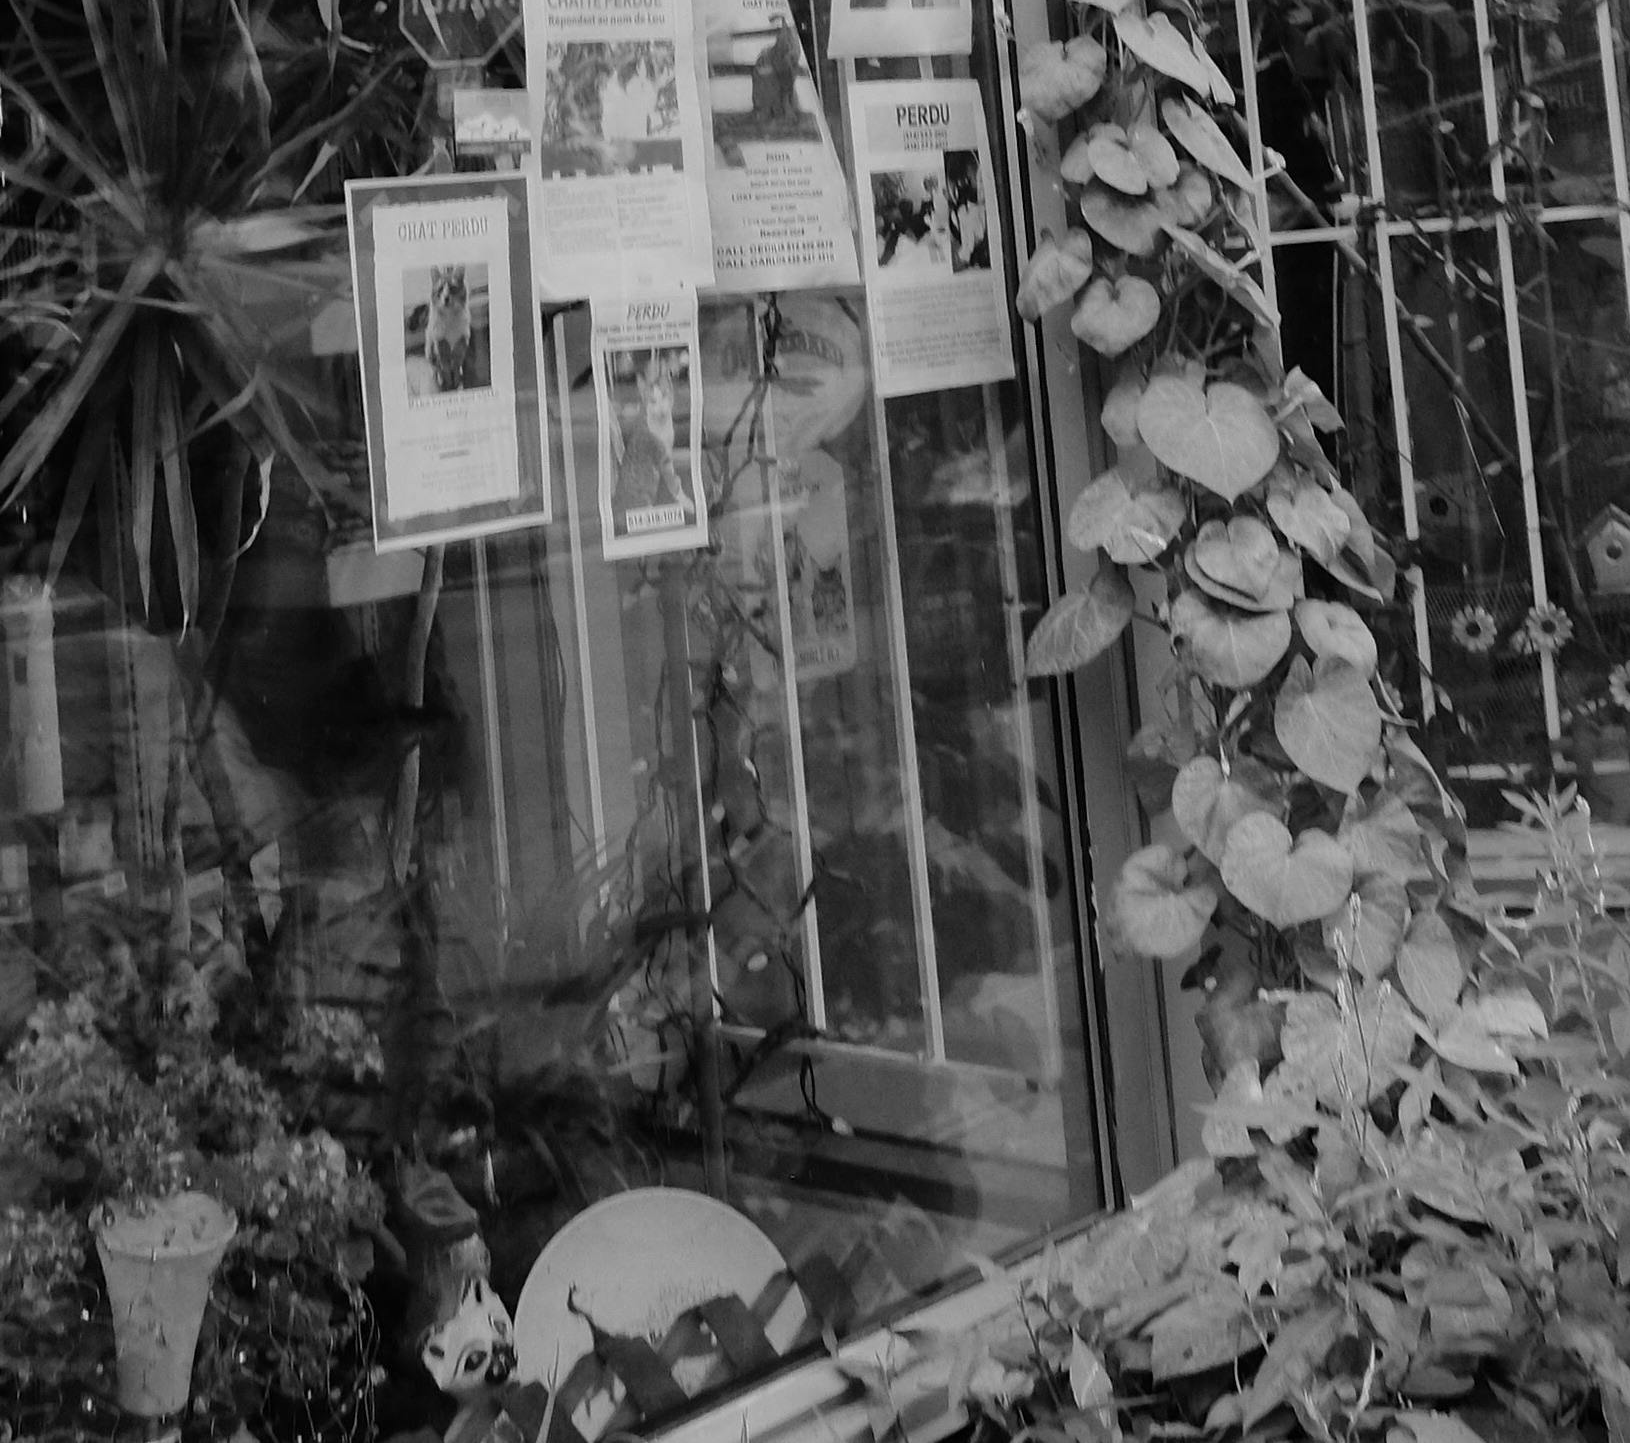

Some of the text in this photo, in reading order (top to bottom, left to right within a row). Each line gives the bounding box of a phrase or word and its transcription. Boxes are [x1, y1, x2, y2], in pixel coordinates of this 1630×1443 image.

[896, 103, 950, 127] PERDU
[398, 216, 488, 242] CHAT PERDU
[626, 301, 670, 322] PERDU
